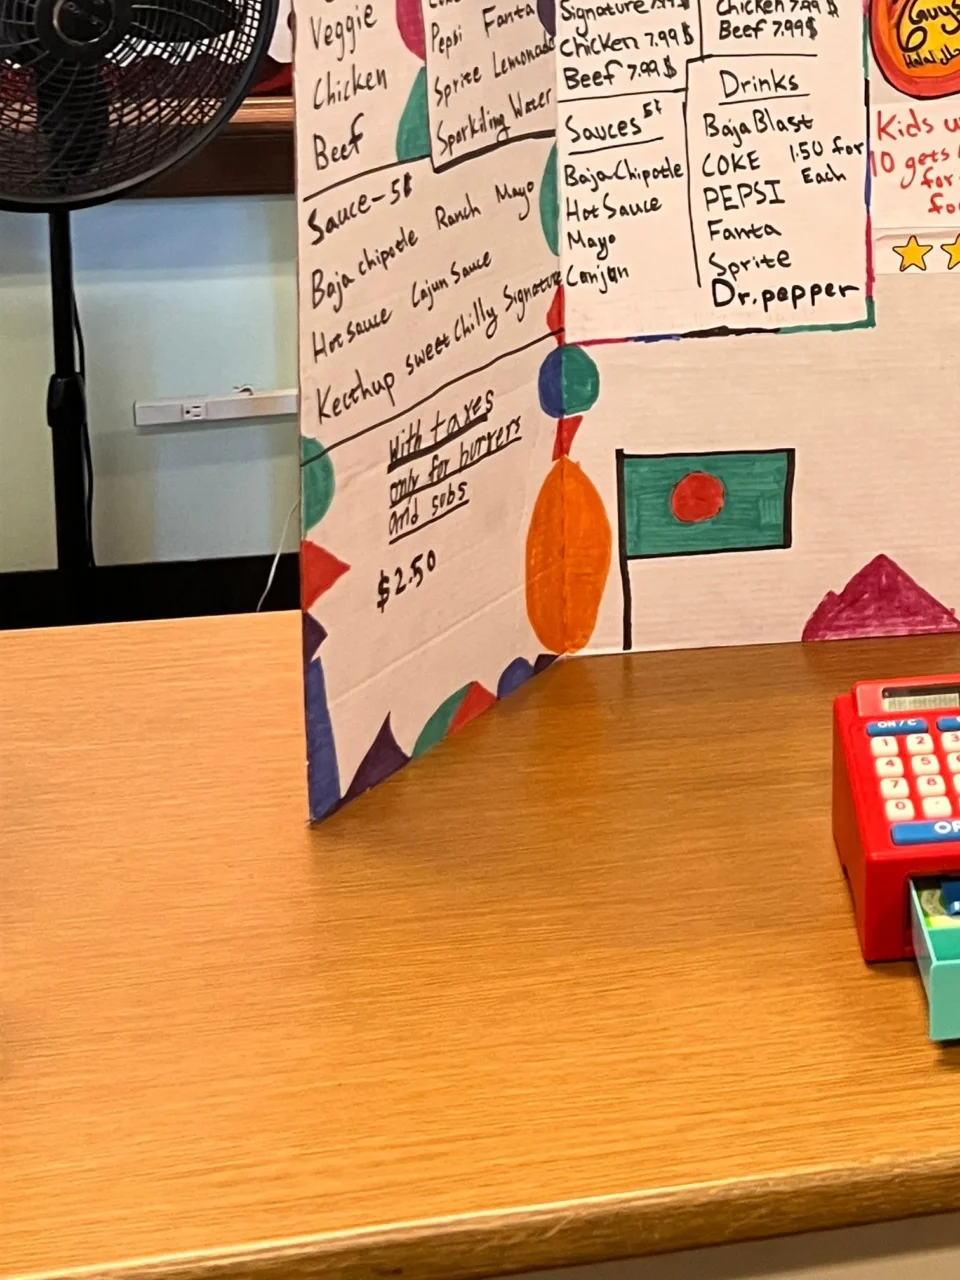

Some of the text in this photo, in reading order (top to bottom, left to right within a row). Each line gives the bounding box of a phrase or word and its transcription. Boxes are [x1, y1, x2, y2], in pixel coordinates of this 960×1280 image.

[310, 3, 377, 61] Veggie
[482, 5, 535, 37] Fanta
[719, 20, 767, 40] Beef
[432, 22, 462, 58] Pepsi
[560, 35, 639, 57] Chicken
[314, 64, 387, 110] Chicken
[434, 67, 482, 108] Sprite
[563, 60, 624, 90] Beef
[719, 69, 799, 98] Drinks
[566, 115, 642, 143] Sauces
[876, 109, 933, 140] Kids
[314, 113, 364, 170] Beef
[833, 136, 864, 156] for
[702, 151, 761, 177] COKE
[801, 164, 846, 184] Each
[871, 149, 896, 177] 10
[900, 147, 950, 188] gets
[920, 168, 955, 189] for
[567, 193, 663, 221] Hot Sauce
[704, 180, 786, 211] PEPSI
[308, 194, 371, 245] Sauce
[708, 219, 782, 240] Fanta
[312, 269, 354, 312] Baja
[435, 193, 481, 230] Ranch
[496, 182, 534, 220] Mayo
[567, 232, 616, 260] Mayo
[709, 249, 792, 281] Sprite
[411, 278, 449, 311] Cajun
[762, 281, 860, 312] pepper
[454, 298, 498, 339] Chilly
[431, 390, 494, 442] taxes
[432, 481, 468, 516] subs
[377, 549, 436, 613] $2.50
[916, 737, 925, 745] 2
[952, 734, 960, 742] 3
[921, 757, 930, 765] 5
[892, 780, 899, 788] 7
[927, 778, 936, 786] 8
[895, 802, 906, 810] 0
